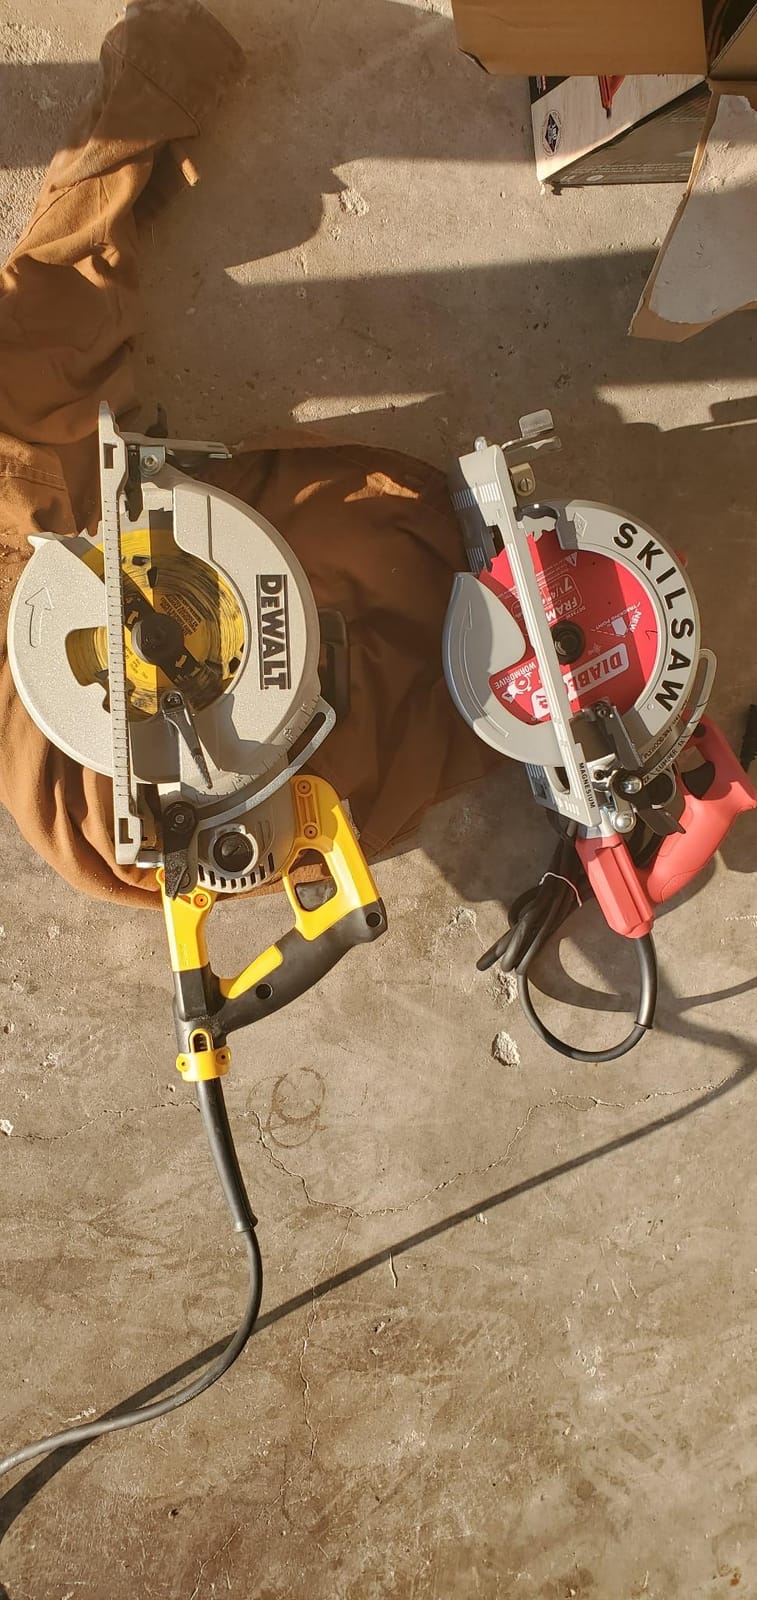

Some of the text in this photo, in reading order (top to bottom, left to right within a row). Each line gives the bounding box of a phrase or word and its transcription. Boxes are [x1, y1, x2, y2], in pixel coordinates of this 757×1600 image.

[546, 597, 578, 622] FRAM
[613, 522, 694, 712] SKILSAW
[630, 611, 642, 632] NEW
[495, 661, 536, 690] WORMDRIVE
[563, 651, 623, 698] DIABL
[579, 762, 596, 809] MAGNESIUM
